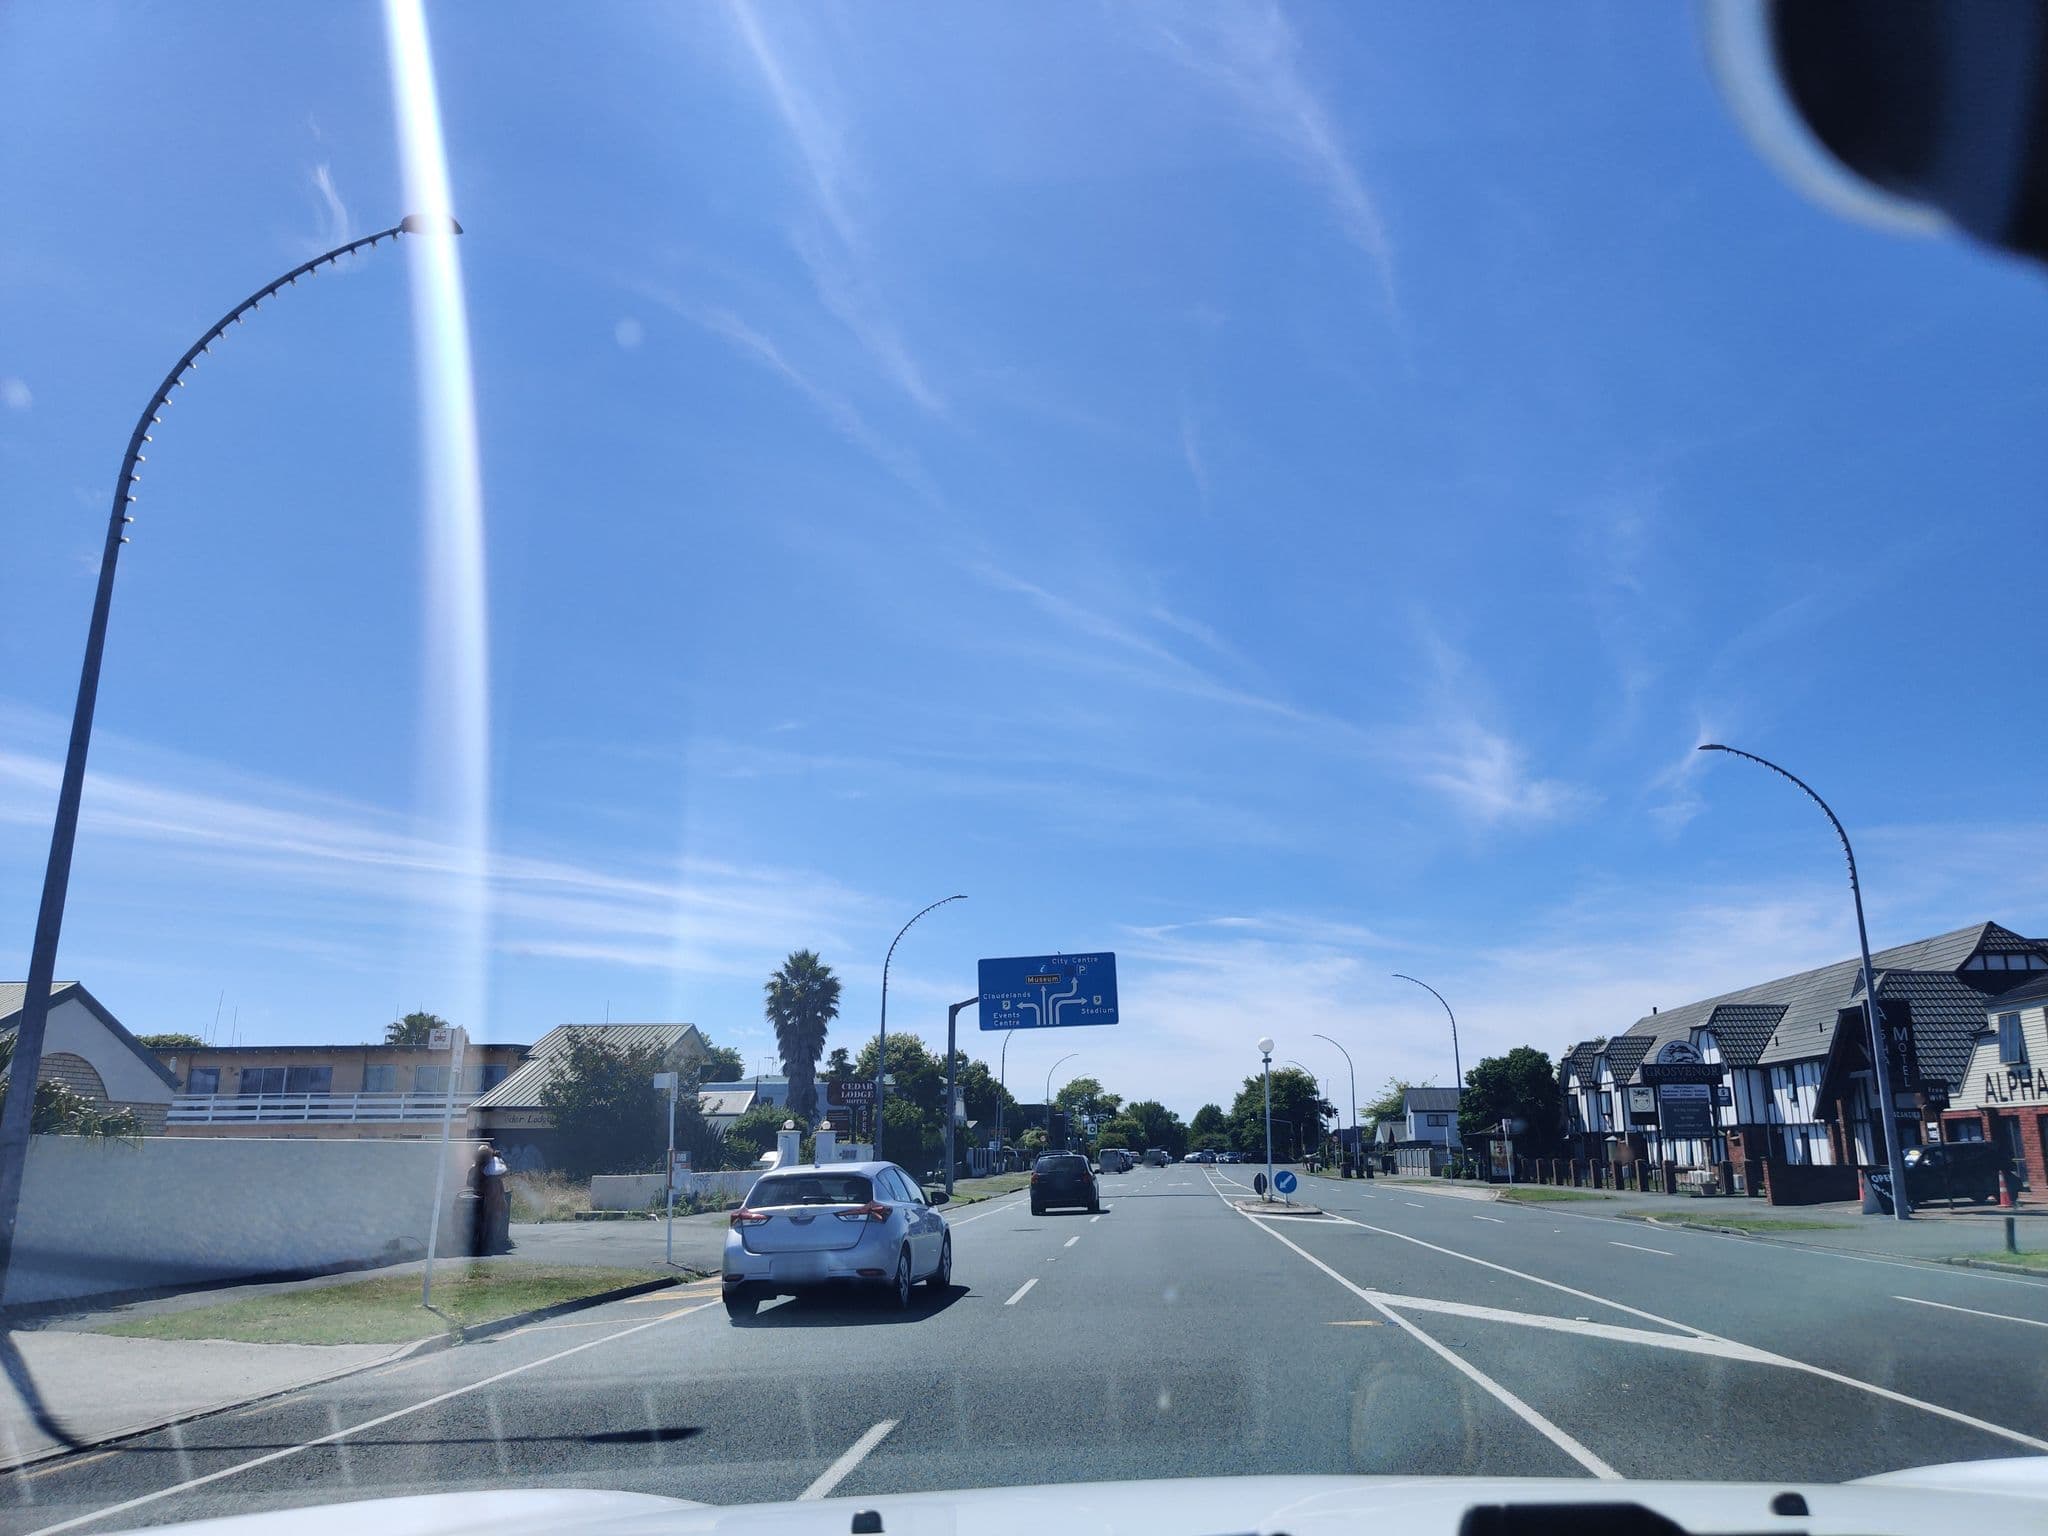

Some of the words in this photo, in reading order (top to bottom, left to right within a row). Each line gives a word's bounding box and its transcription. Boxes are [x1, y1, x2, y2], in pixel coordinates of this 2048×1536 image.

[1072, 956, 1098, 964] Centre
[982, 991, 1031, 1000] Claudelands
[1081, 1007, 1115, 1015] Stadium
[1893, 1026, 1911, 1088] MOTEL
[1645, 1066, 1719, 1077] GROSVENOR
[841, 1082, 874, 1091] CEDAR
[1985, 1068, 2048, 1104] ALPHA
[841, 1090, 874, 1098] LODGE
[1871, 1174, 1892, 1183] OPE
